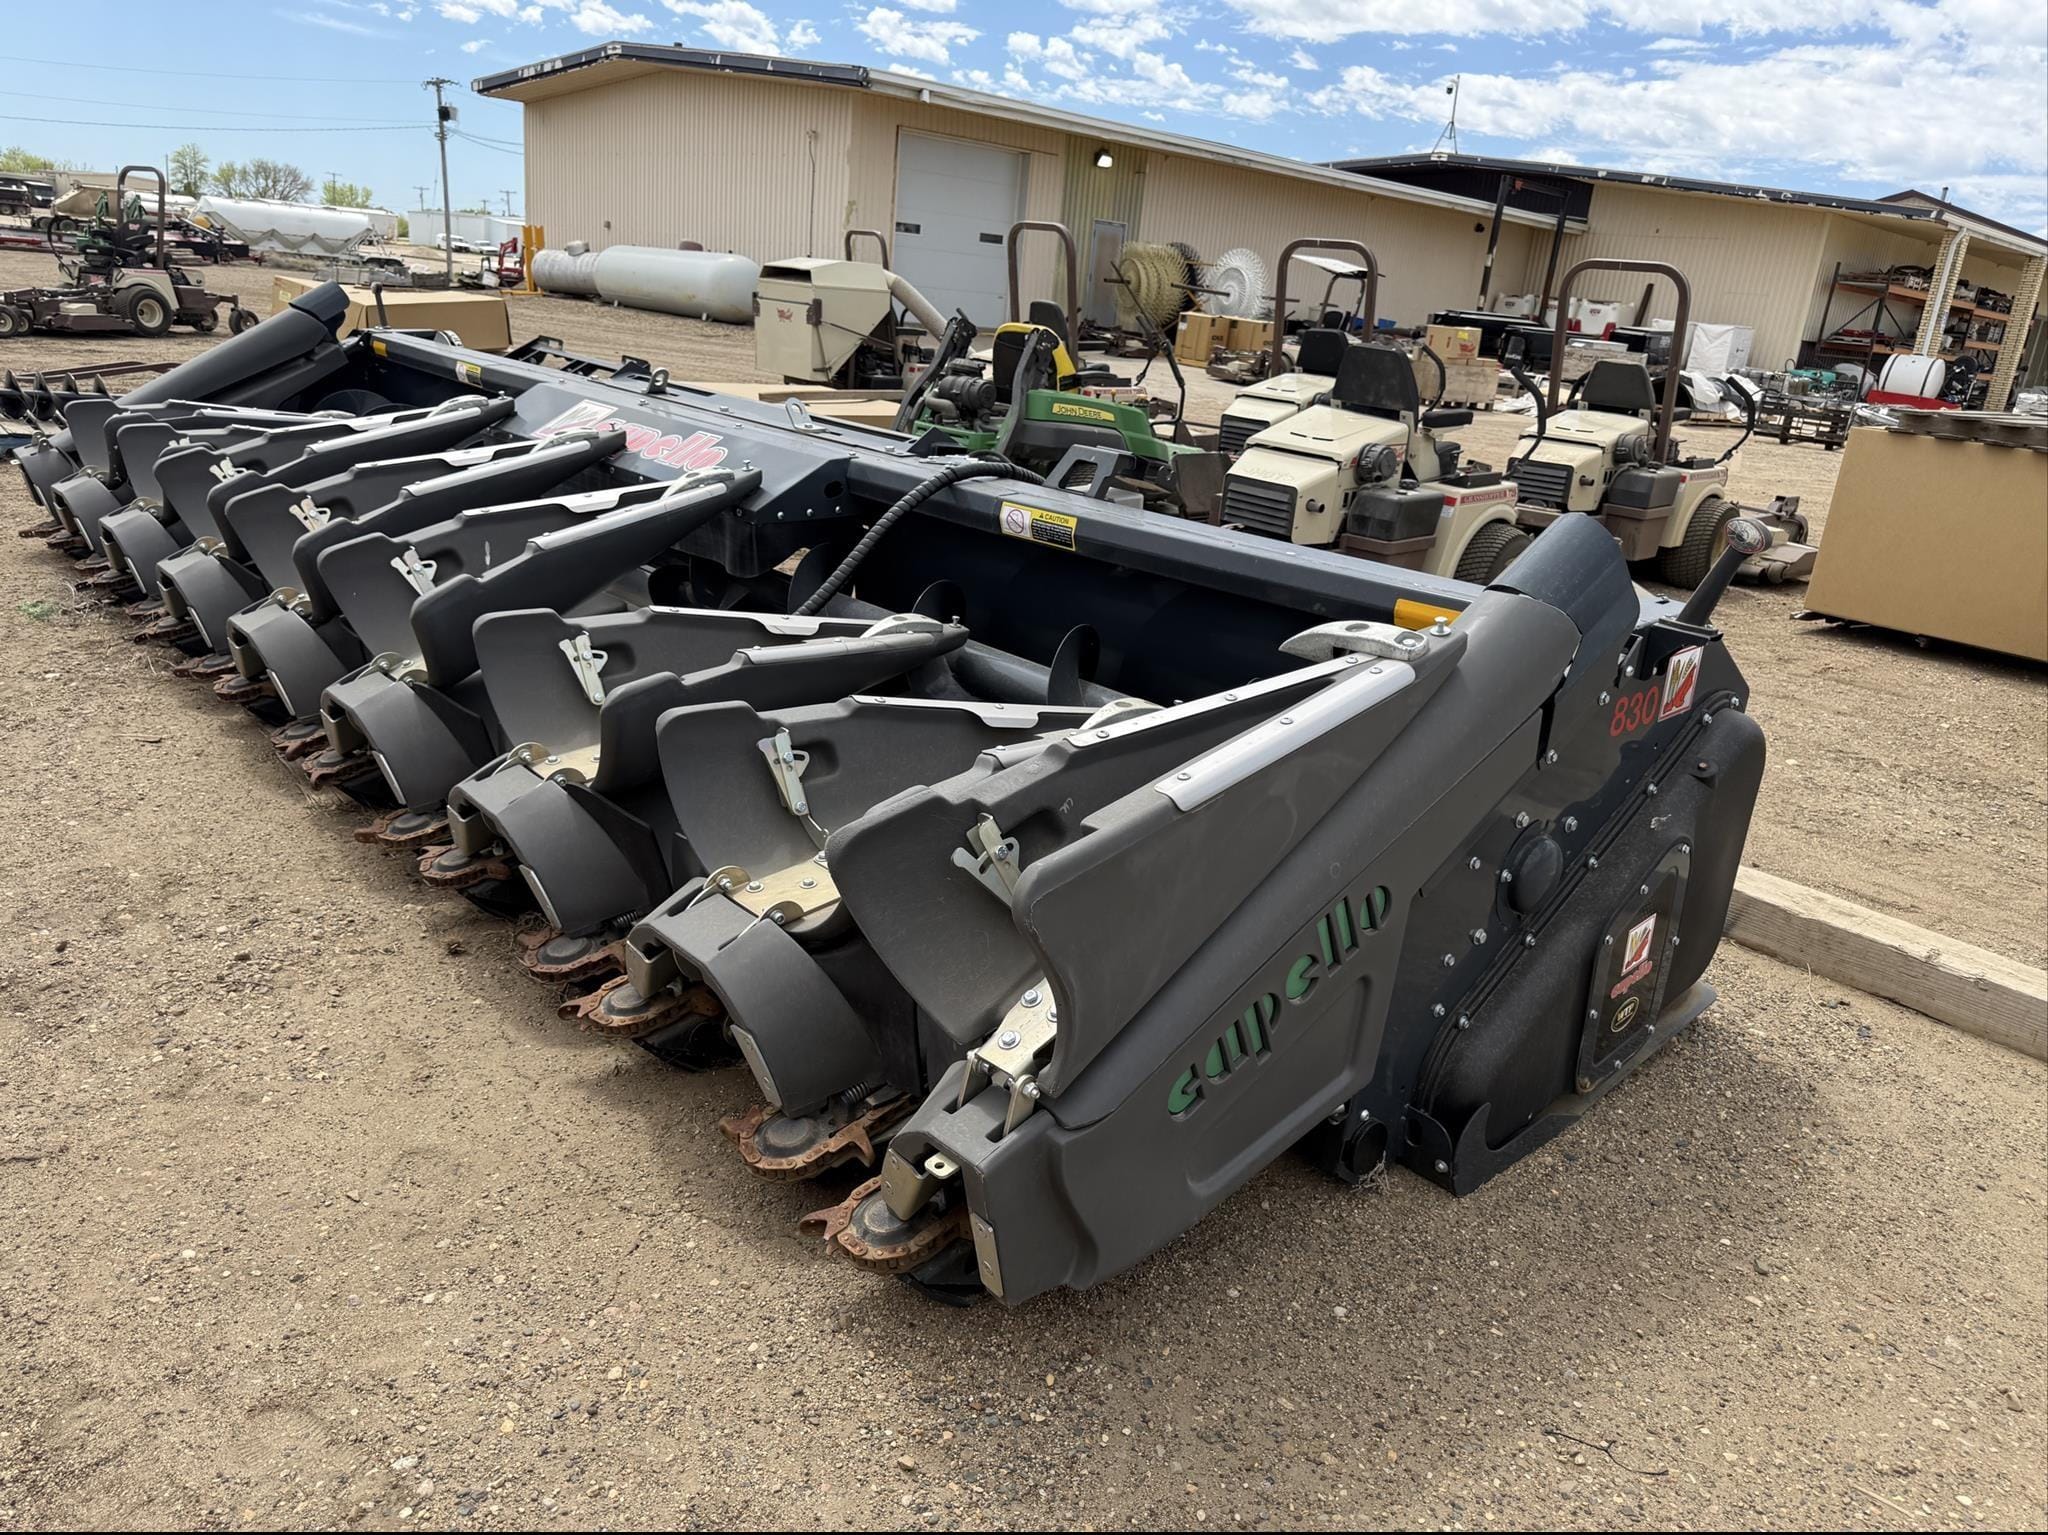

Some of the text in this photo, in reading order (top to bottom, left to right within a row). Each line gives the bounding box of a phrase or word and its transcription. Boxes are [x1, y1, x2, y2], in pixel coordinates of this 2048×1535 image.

[1056, 405, 1104, 420] JOHN DEERE
[1044, 513, 1069, 525] CAUTION
[1610, 686, 1659, 737] 830
[1167, 885, 1392, 1122] capello
